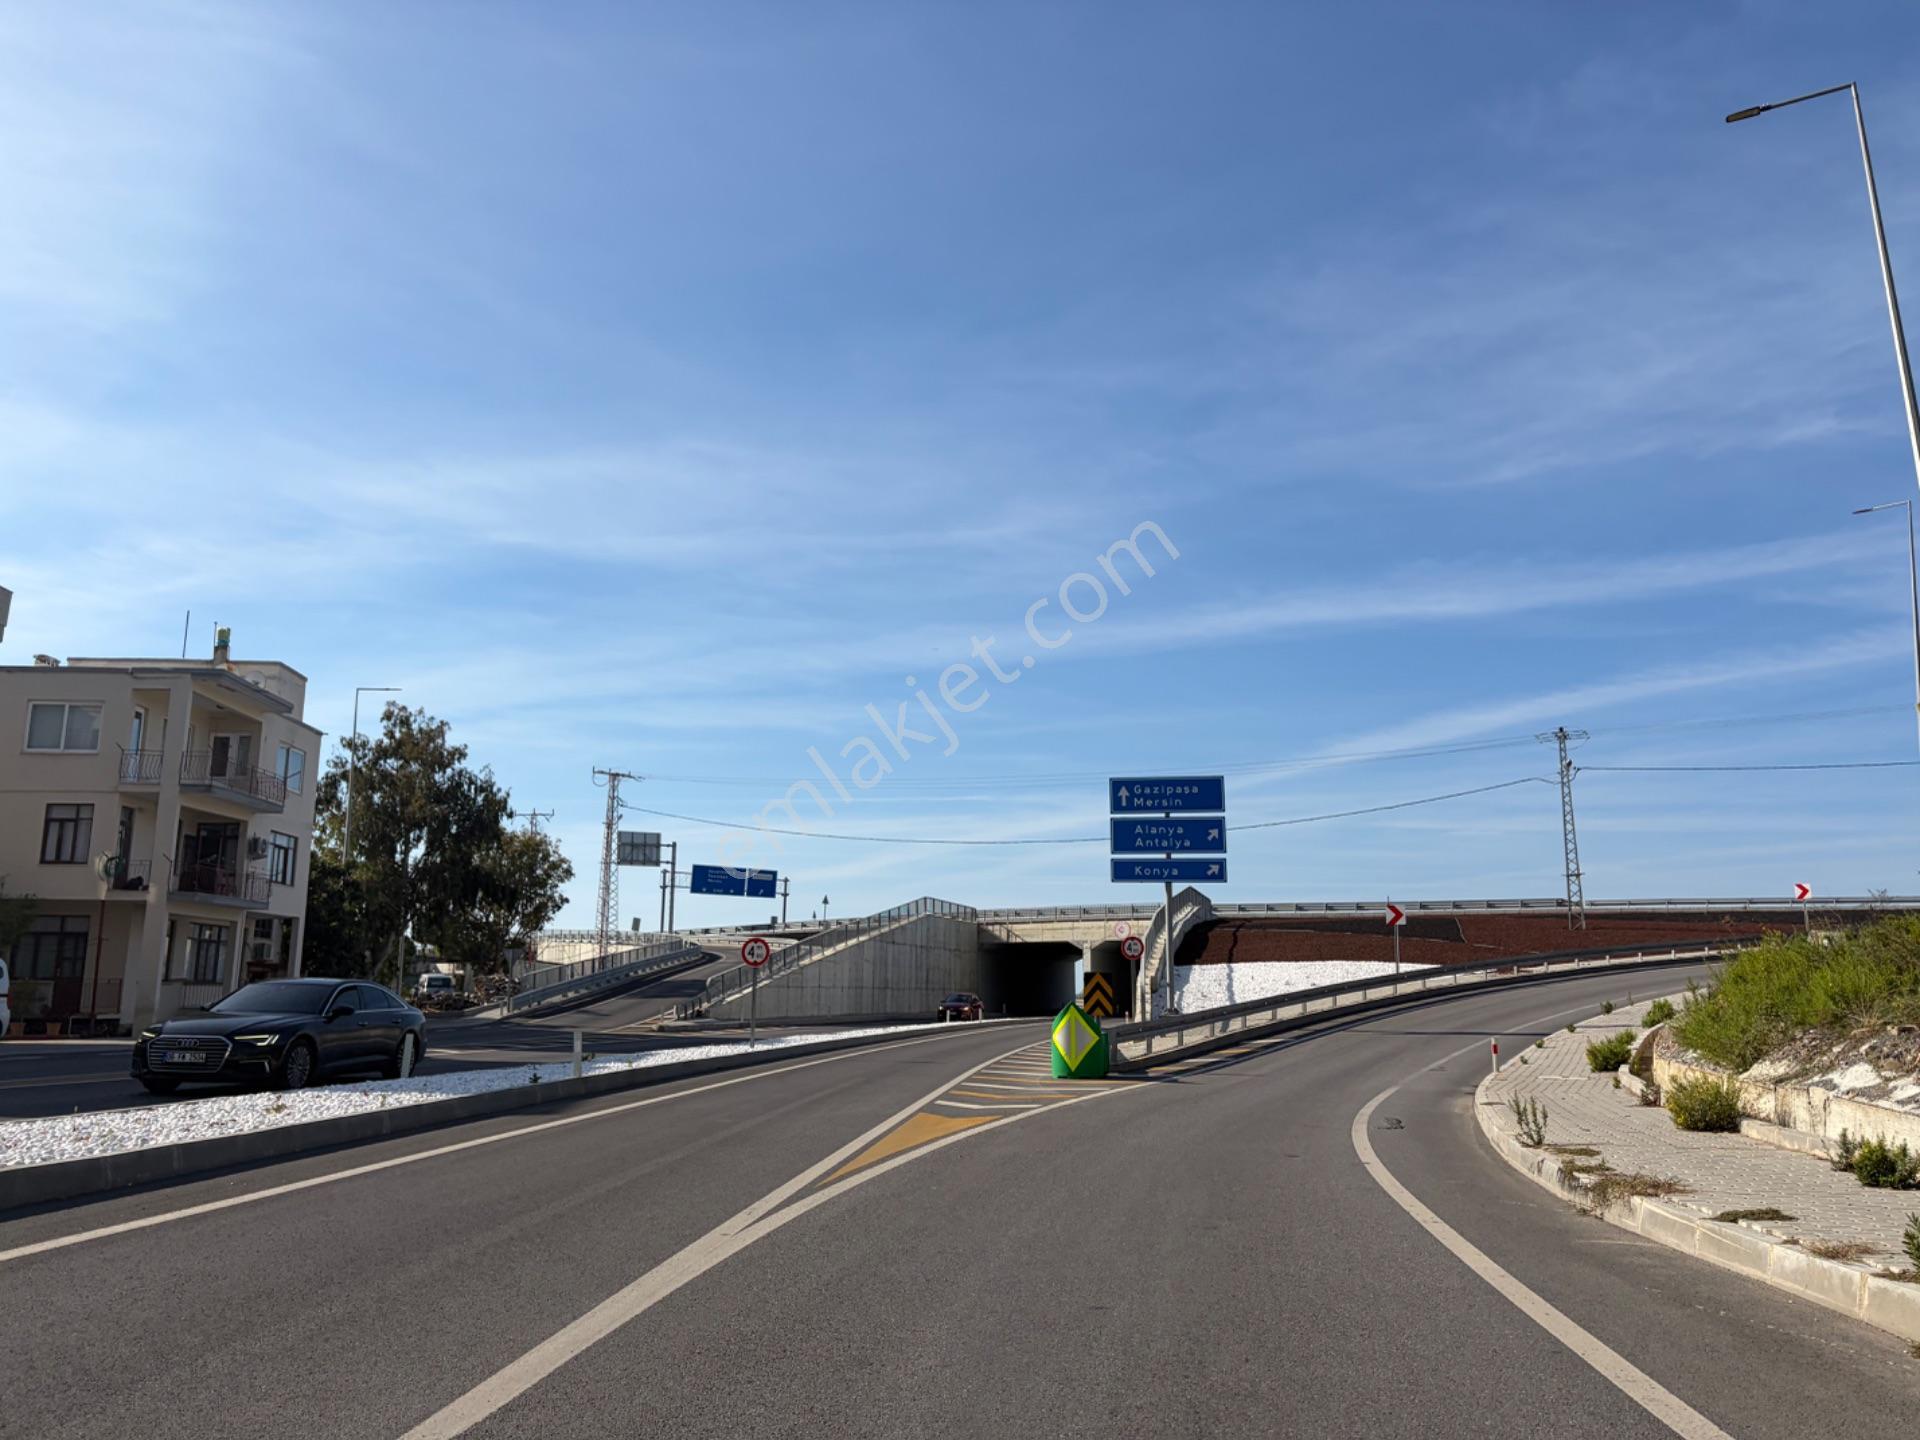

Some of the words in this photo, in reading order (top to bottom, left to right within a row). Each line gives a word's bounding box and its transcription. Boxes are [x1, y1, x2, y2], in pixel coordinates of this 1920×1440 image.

[1134, 798, 1182, 807] Mersin
[1135, 825, 1184, 836] Alanya
[1135, 838, 1191, 848] Antalya
[1135, 866, 1179, 877] Konya
